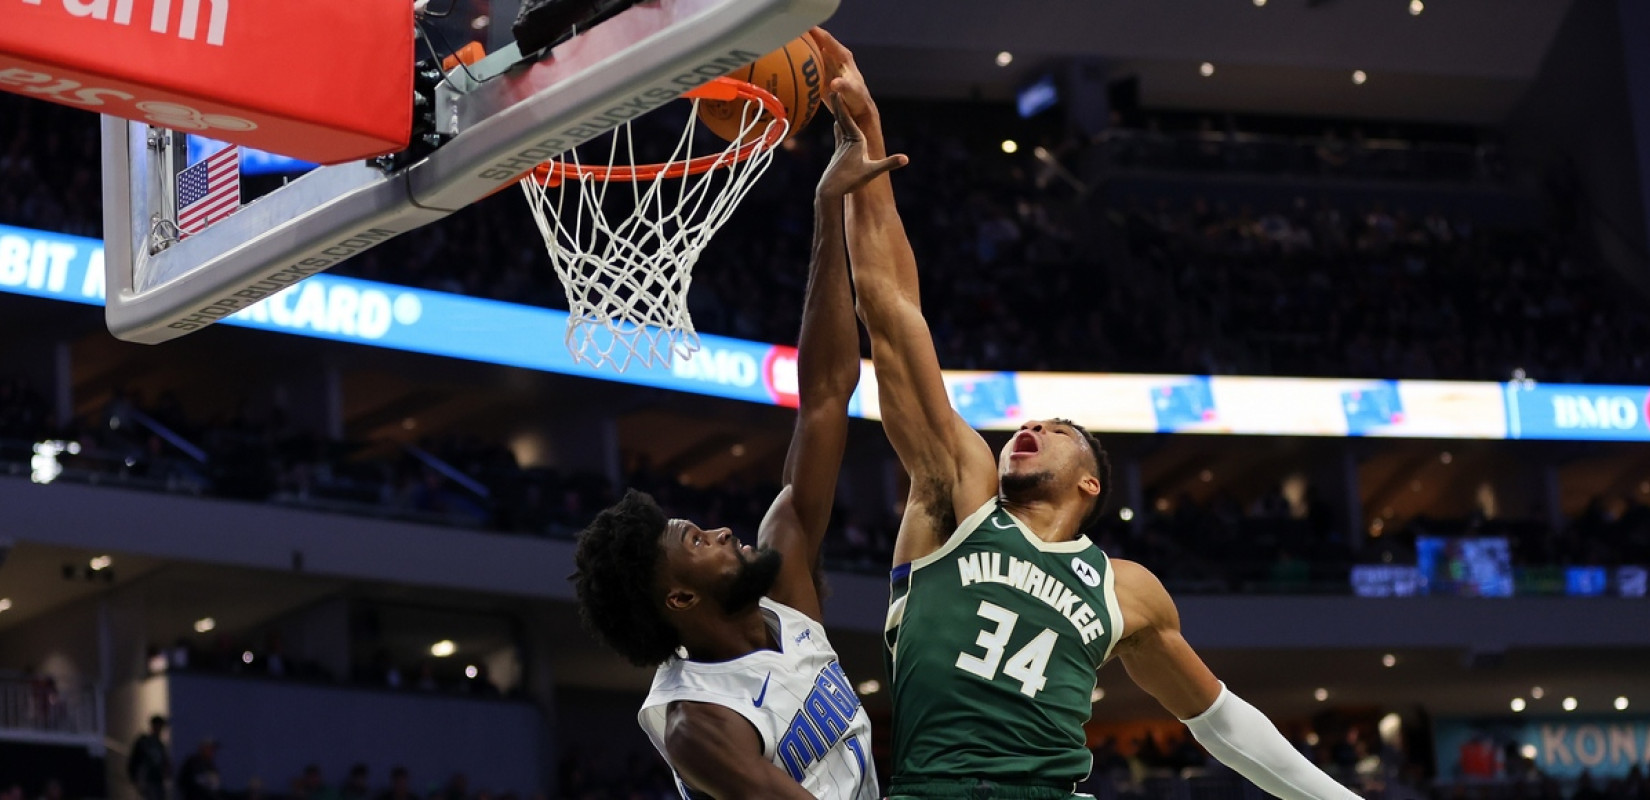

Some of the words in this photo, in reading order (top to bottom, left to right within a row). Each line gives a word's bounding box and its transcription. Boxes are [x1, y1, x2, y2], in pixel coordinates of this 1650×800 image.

[22, 0, 229, 46] arm
[478, 49, 758, 181] SHOP.BUCKS.COM
[168, 228, 397, 331] SHOP.BUCKS.COM
[673, 343, 758, 388] BMO
[1552, 394, 1638, 430] BMO
[957, 552, 1105, 645] MILWAUKEE
[955, 600, 1059, 698] 34
[1542, 724, 1650, 766] KON
